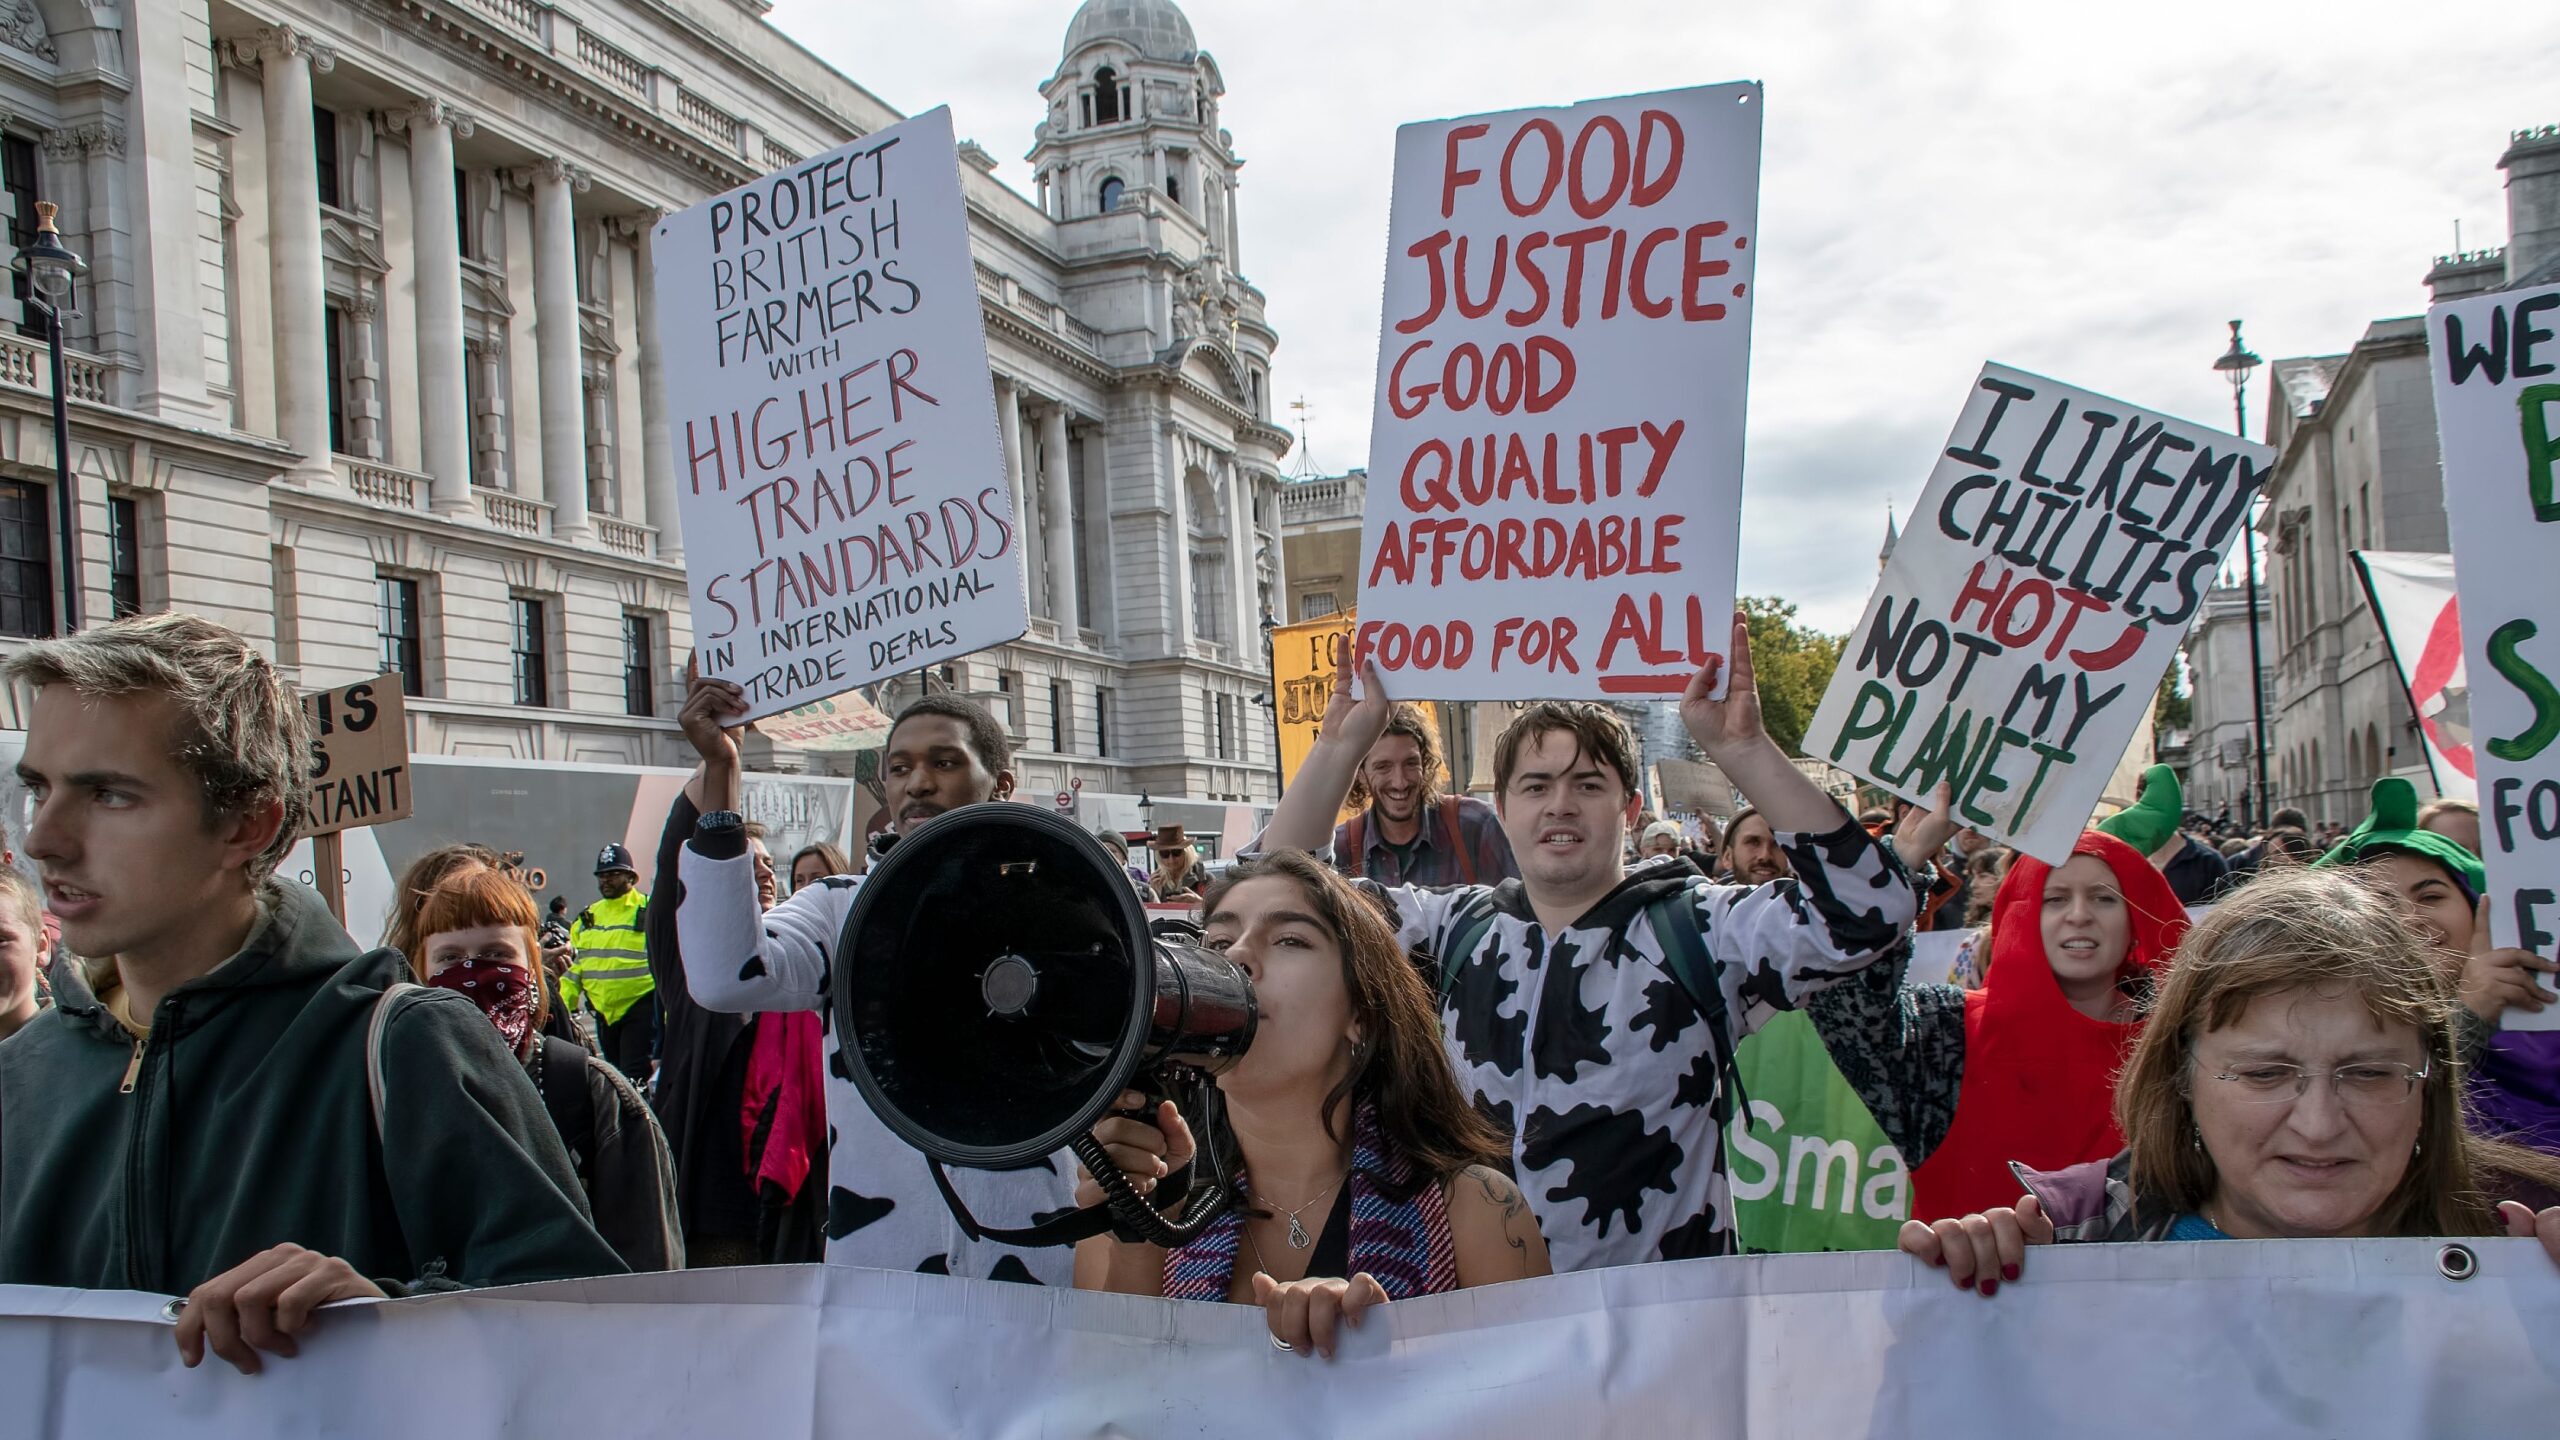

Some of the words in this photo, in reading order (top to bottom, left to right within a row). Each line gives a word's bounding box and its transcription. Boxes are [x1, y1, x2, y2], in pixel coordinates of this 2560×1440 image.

[711, 137, 900, 253] PROTECT
[1441, 110, 1685, 219] FOOD
[713, 198, 899, 311] BRITISH
[1395, 221, 1748, 334] JUSTICE:
[717, 259, 920, 368] FARMERS
[769, 340, 840, 380] WITH
[686, 348, 940, 495] HIGHER
[1389, 336, 1577, 420] GOOD
[1946, 377, 2035, 470] I
[737, 439, 917, 559] TRADE
[1400, 419, 1685, 513] QUALITY
[706, 487, 1012, 639] STANDARDS
[1368, 514, 1686, 587] AFFORDABLE
[1938, 474, 2219, 626] CHILLIES
[706, 642, 734, 676] IN
[762, 569, 994, 658] INTERNATIONAL
[745, 650, 847, 704] TRADE
[869, 621, 958, 672] DEALS
[1310, 629, 1355, 671] FO
[1354, 619, 1474, 680] FOOD
[1492, 616, 1580, 675] FOR
[1596, 592, 1724, 672] ALL
[1951, 560, 2112, 662] HOT
[302, 684, 378, 736] IS
[1856, 595, 2003, 702] NOT
[2000, 663, 2125, 751] MY
[764, 714, 886, 742] JUSTICE
[1829, 679, 2077, 837] PLANET
